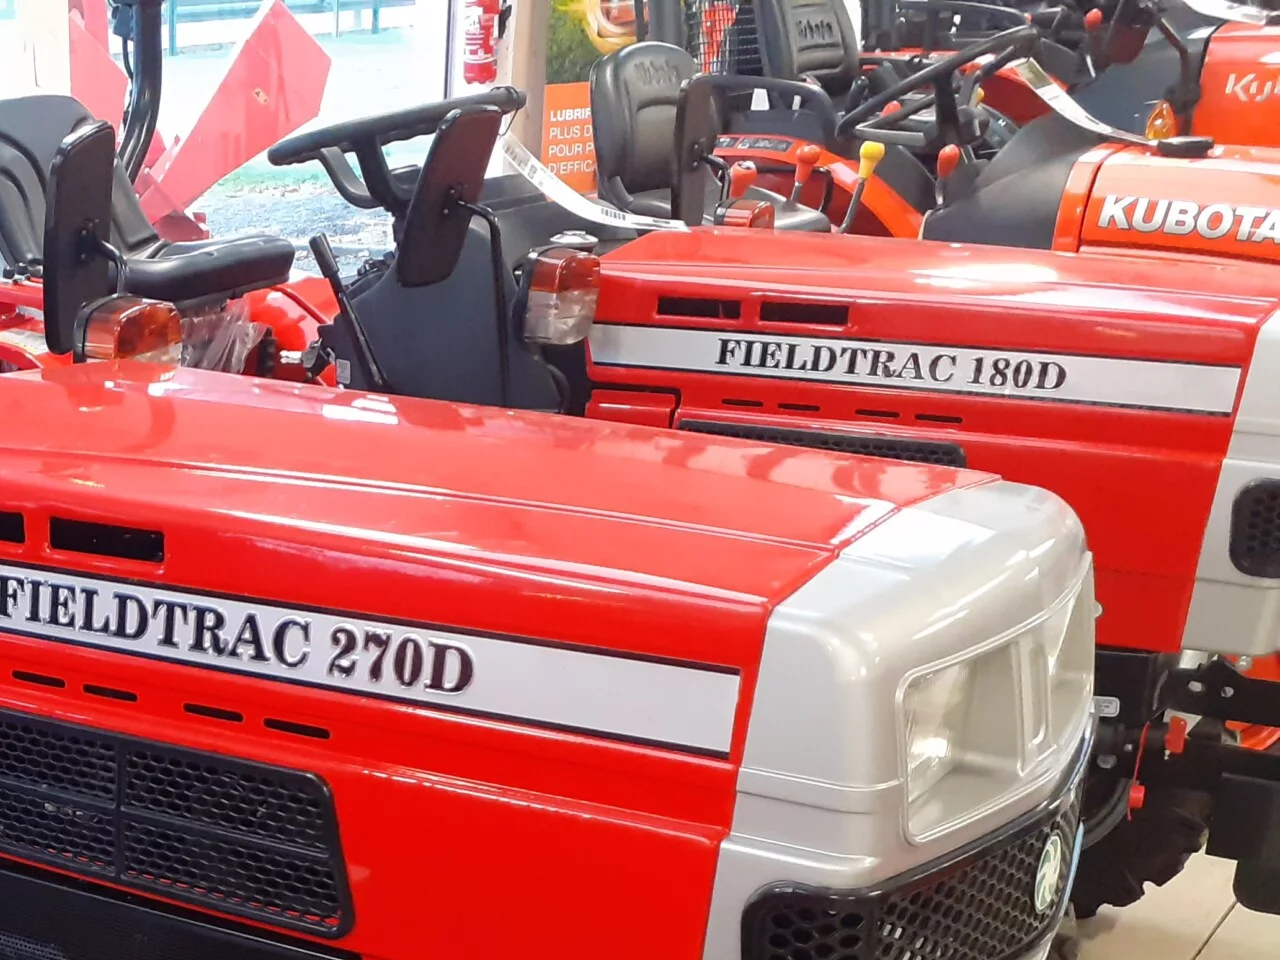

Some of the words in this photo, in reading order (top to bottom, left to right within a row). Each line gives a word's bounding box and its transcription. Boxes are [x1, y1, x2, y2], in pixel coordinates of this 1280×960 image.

[548, 143, 583, 157] POUR
[549, 125, 581, 140] PLUS
[1097, 194, 1280, 244] KUBOTA
[715, 338, 958, 383] FIELDTRAC
[967, 355, 1068, 391] 180D
[327, 623, 476, 696] 270D
